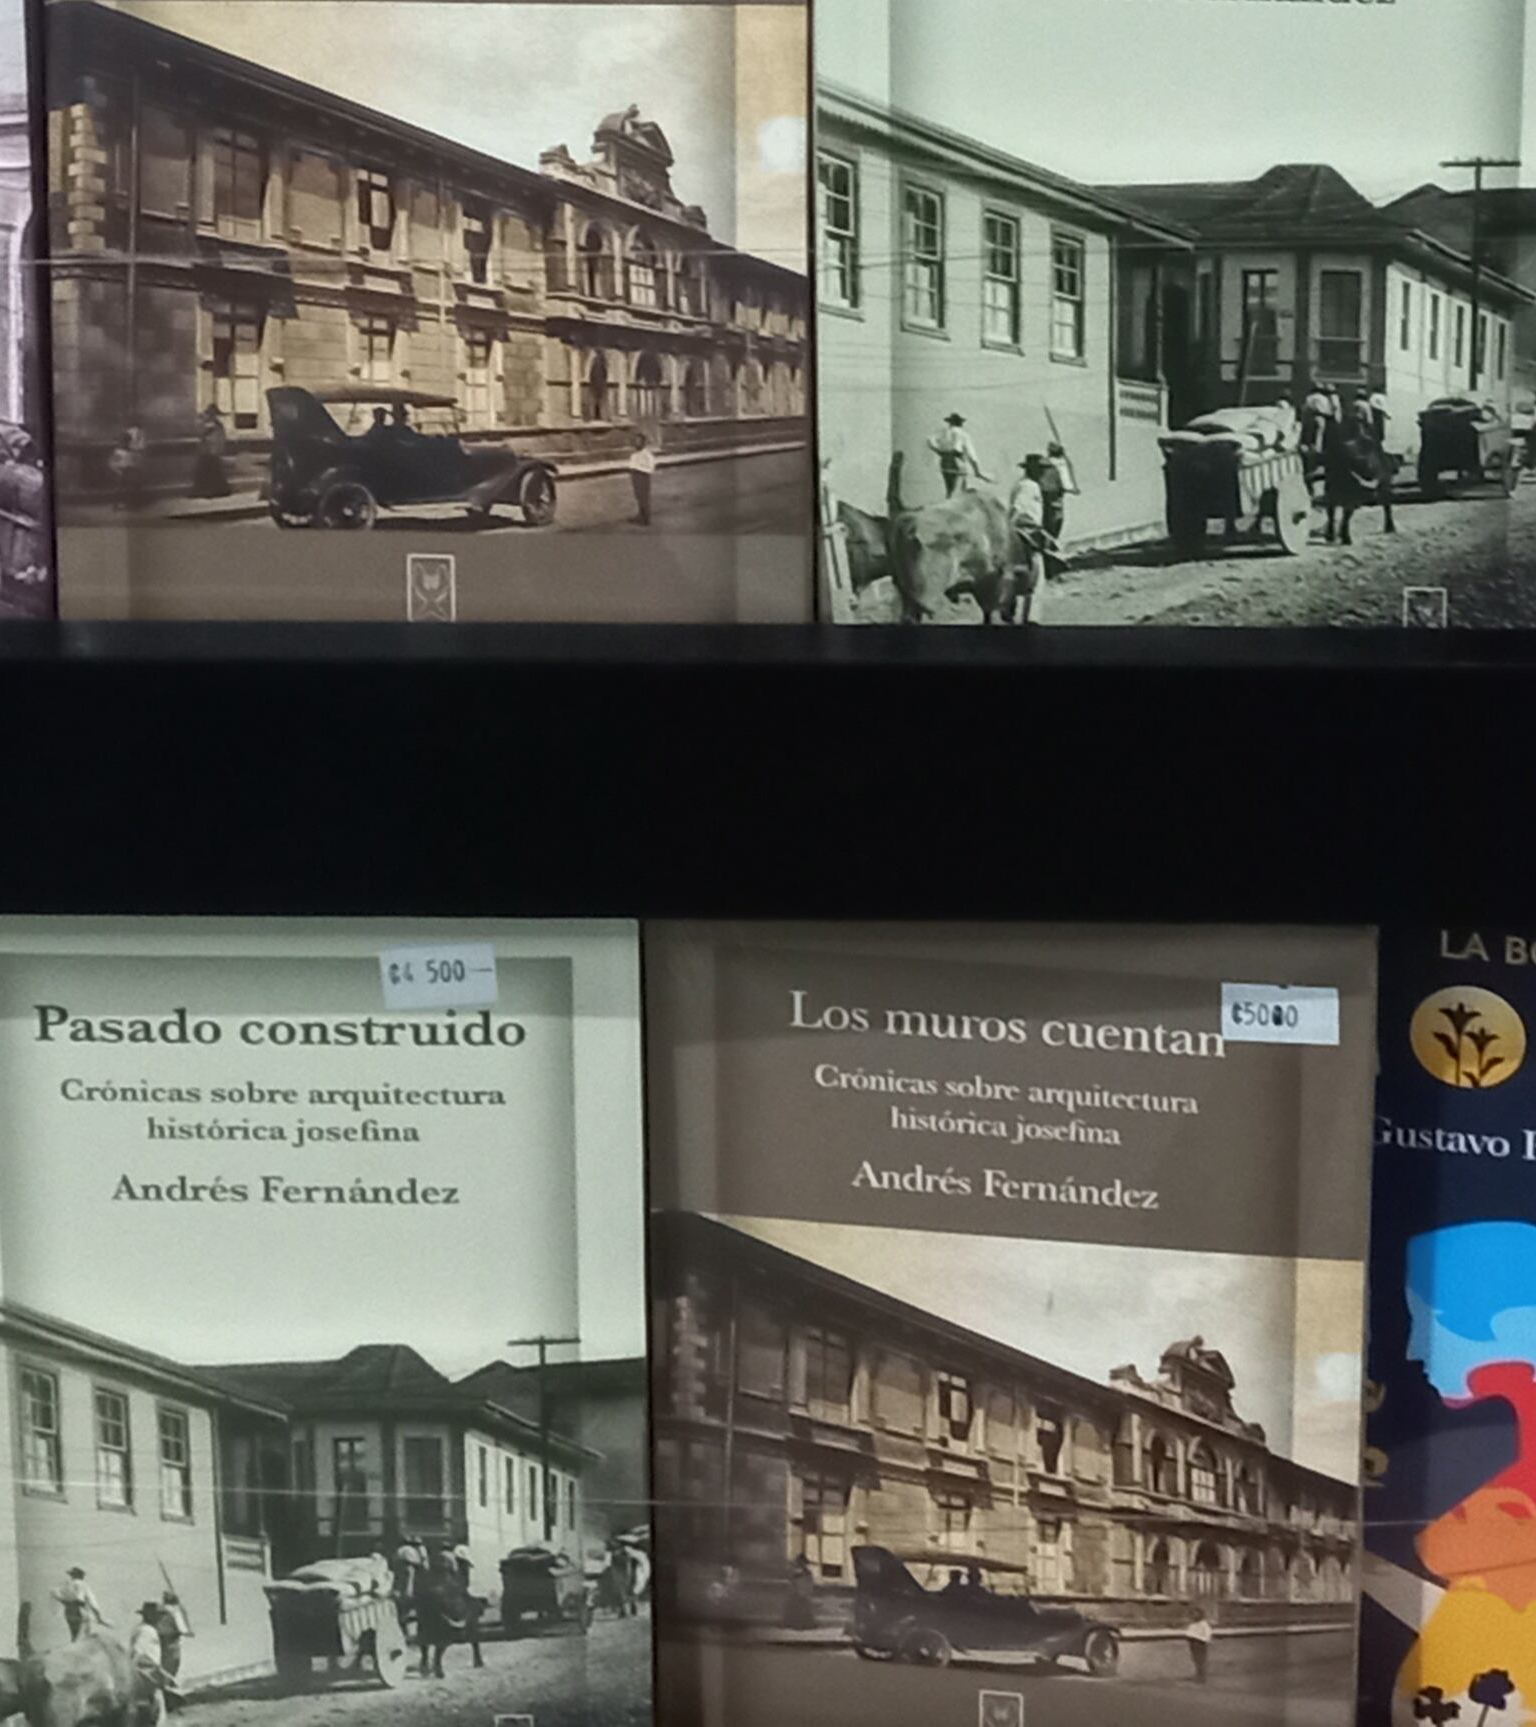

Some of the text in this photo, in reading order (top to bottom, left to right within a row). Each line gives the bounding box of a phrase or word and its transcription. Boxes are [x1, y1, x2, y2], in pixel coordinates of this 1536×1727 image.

[1440, 929, 1490, 962] LA
[34, 1004, 526, 1047] Pasado construido
[790, 990, 1226, 1059] Los muros cuentan
[60, 1078, 506, 1112] Crónicas sobre arquitectura
[814, 1064, 1199, 1114] Crónicas sobre arquitectura
[147, 1116, 420, 1148] histórica josefina
[891, 1105, 1121, 1145] histórica josefina
[112, 1174, 460, 1205] Andrés Fernández
[851, 1160, 1159, 1209] Andrés Fernández
